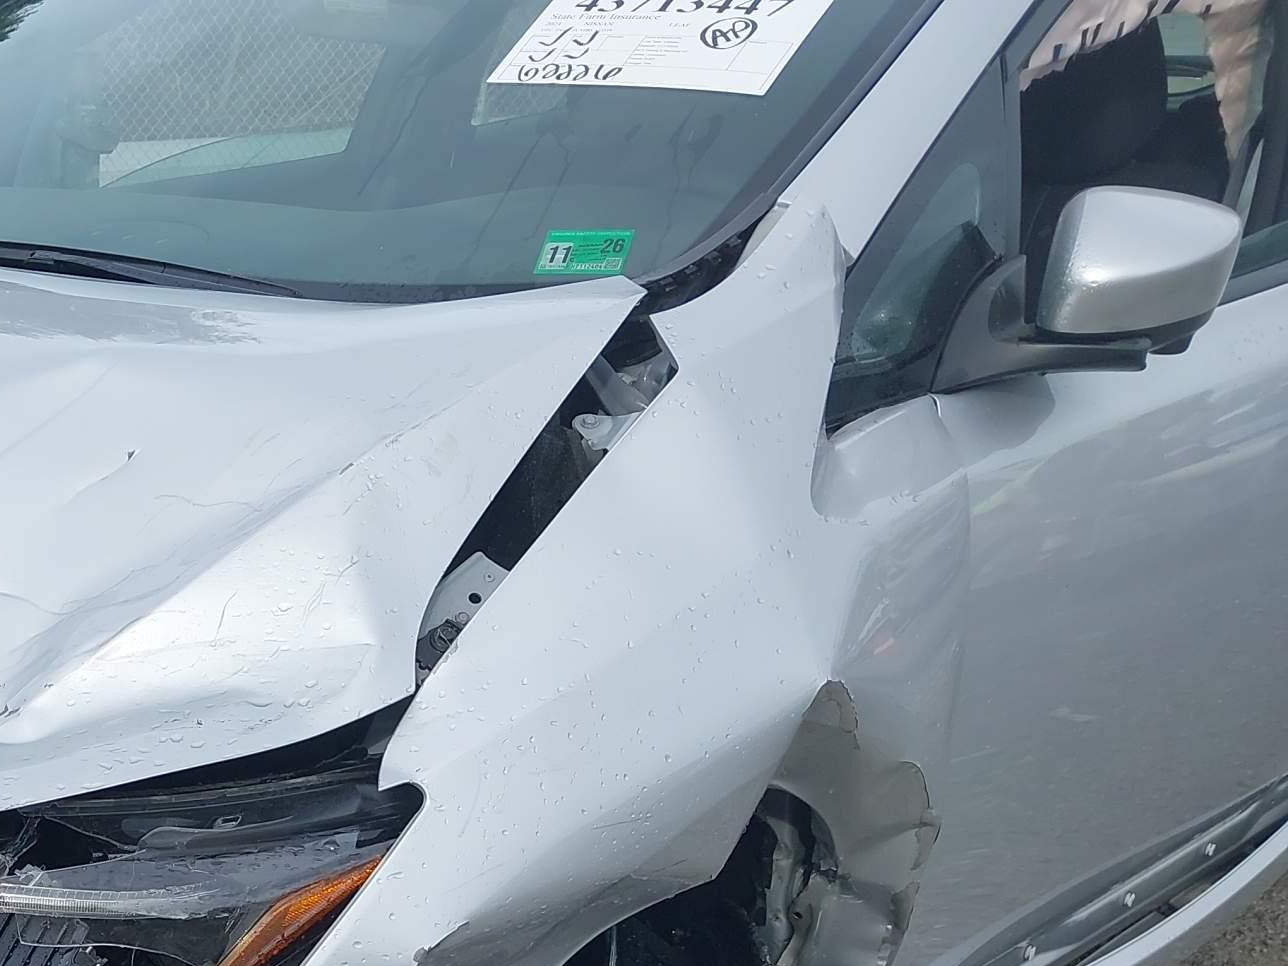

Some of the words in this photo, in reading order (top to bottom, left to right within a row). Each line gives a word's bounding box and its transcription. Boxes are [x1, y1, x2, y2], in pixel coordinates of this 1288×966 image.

[578, 13, 607, 21] Farm
[609, 13, 662, 21] Insurance
[600, 238, 626, 254] 26
[548, 245, 572, 264] 11
